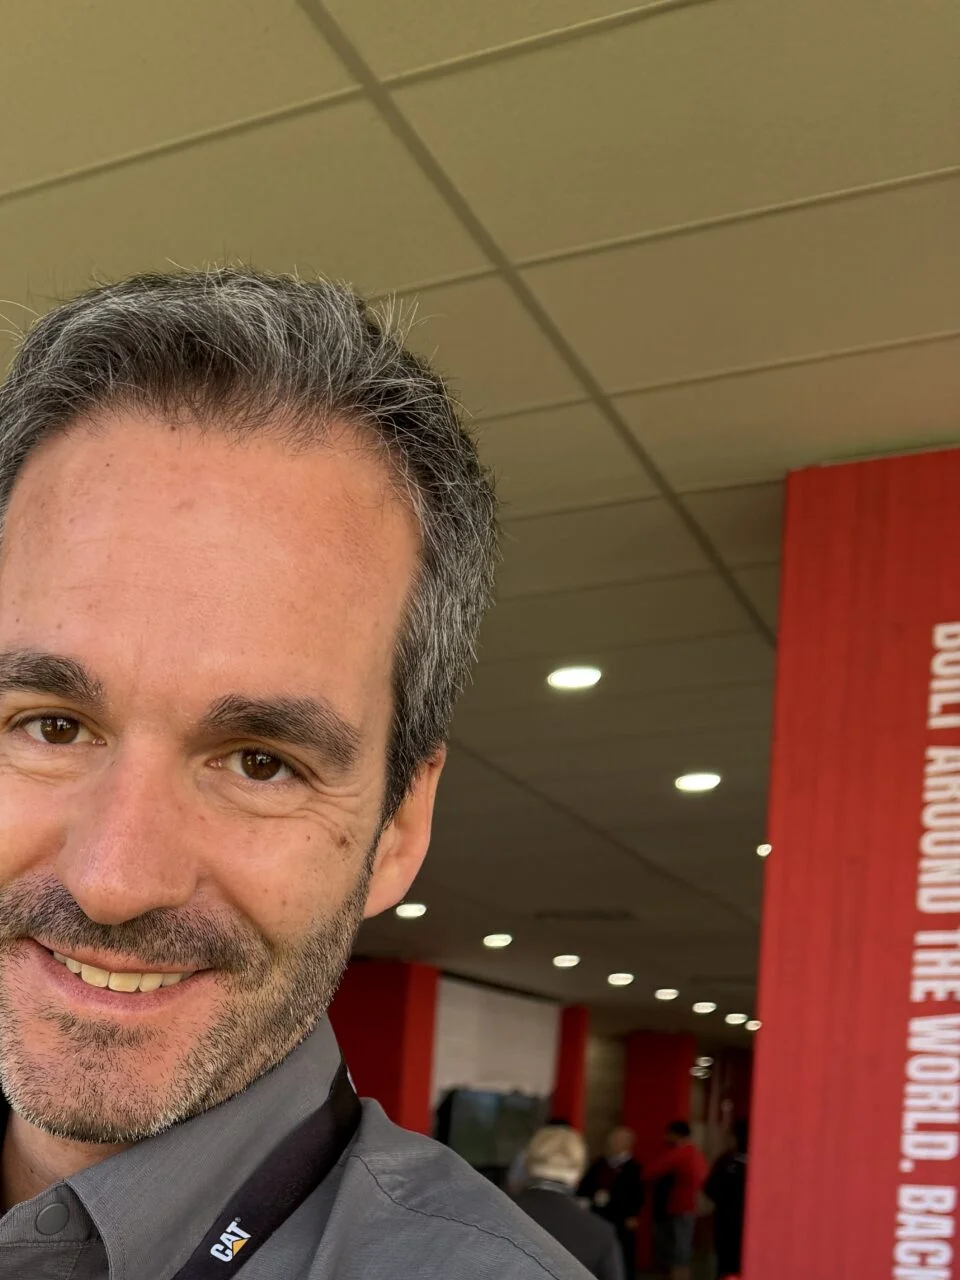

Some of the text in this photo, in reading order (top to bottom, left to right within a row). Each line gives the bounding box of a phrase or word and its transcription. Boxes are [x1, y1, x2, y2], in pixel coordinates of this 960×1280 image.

[916, 745, 960, 913] AROUND
[909, 928, 960, 1003] THE
[898, 1014, 960, 1174] WORLD.
[210, 1220, 252, 1263] CAT
